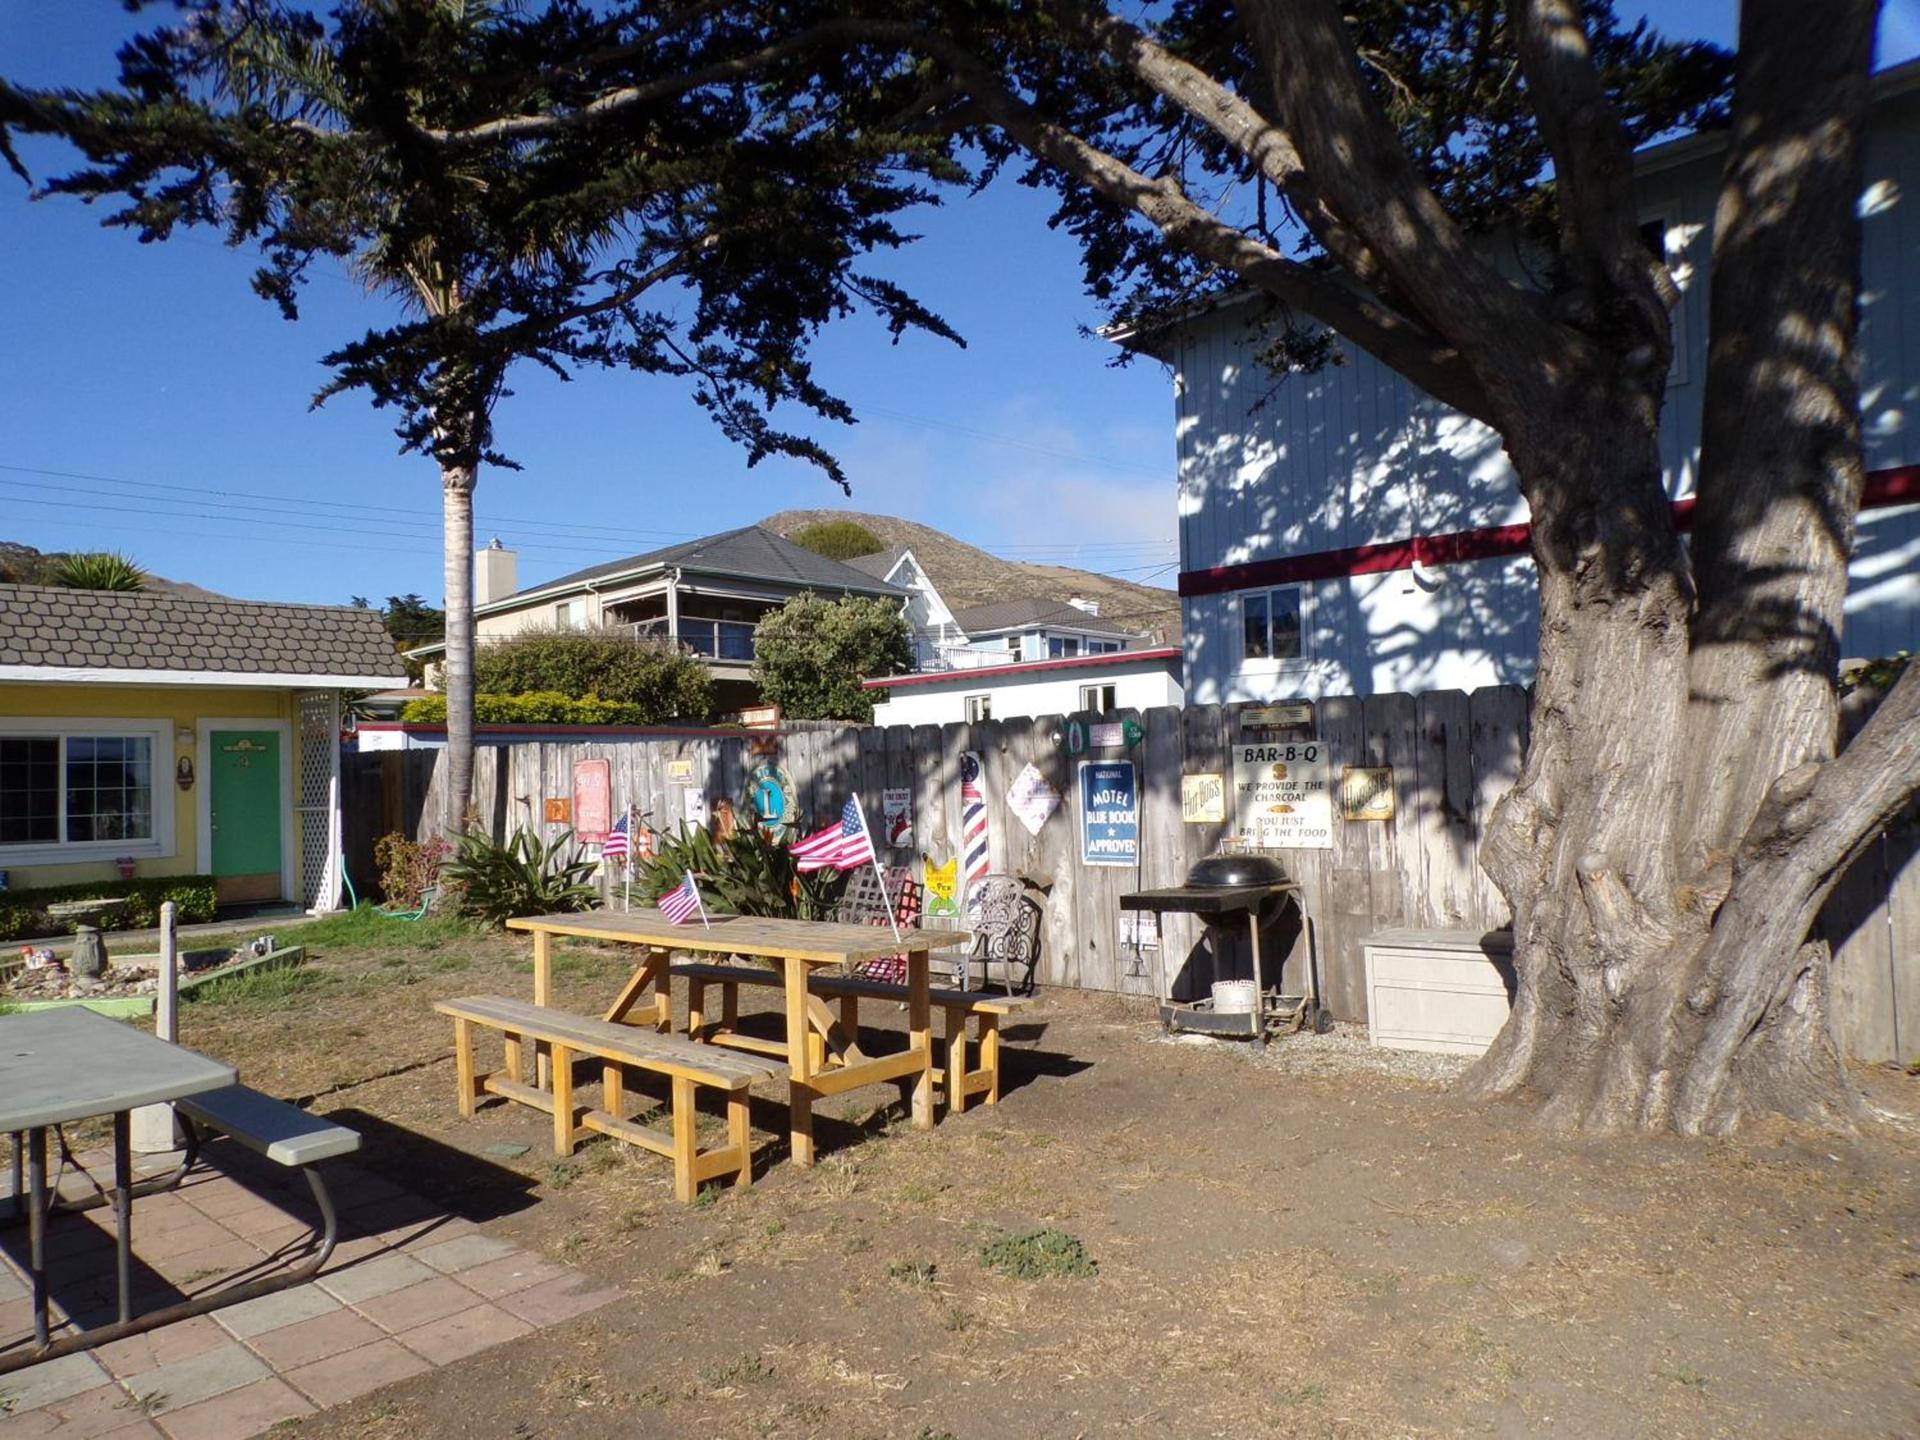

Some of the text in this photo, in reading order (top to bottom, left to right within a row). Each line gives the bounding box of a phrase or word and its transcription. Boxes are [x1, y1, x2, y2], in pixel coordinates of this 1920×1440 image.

[1244, 746, 1318, 762] BAR-B-Q
[1238, 781, 1324, 792] WE PROVIDE THE
[1093, 789, 1128, 807] MOTEL
[1255, 793, 1307, 802] CHARCOAL
[1087, 811, 1136, 824] BLUE BOOK
[1256, 816, 1277, 825] YOU
[1240, 828, 1327, 837] BRIG THE FOOD
[1088, 839, 1135, 853] APPROVED
